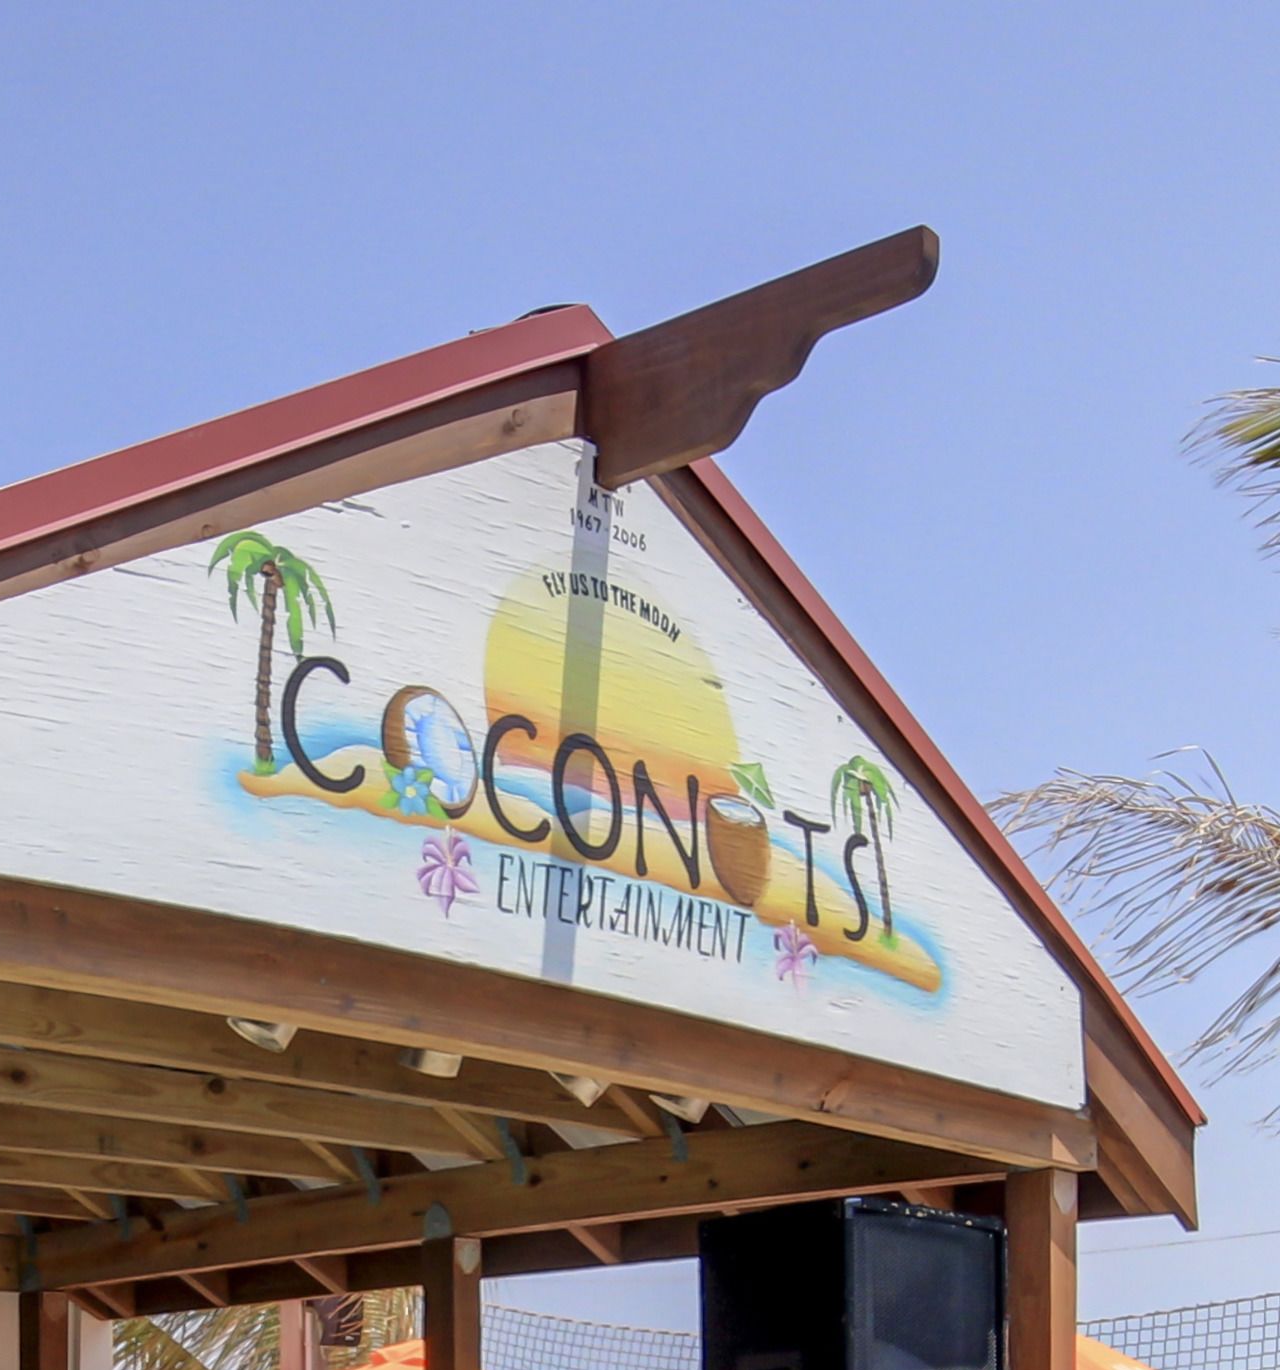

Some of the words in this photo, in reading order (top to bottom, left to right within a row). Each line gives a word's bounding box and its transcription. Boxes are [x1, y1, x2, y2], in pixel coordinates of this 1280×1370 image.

[542, 572, 567, 598] FLY
[570, 573, 590, 597] US
[590, 577, 609, 602] TO
[610, 584, 637, 613] THE
[639, 598, 681, 643] MOON
[496, 852, 752, 964] ENTERTAINMENT
